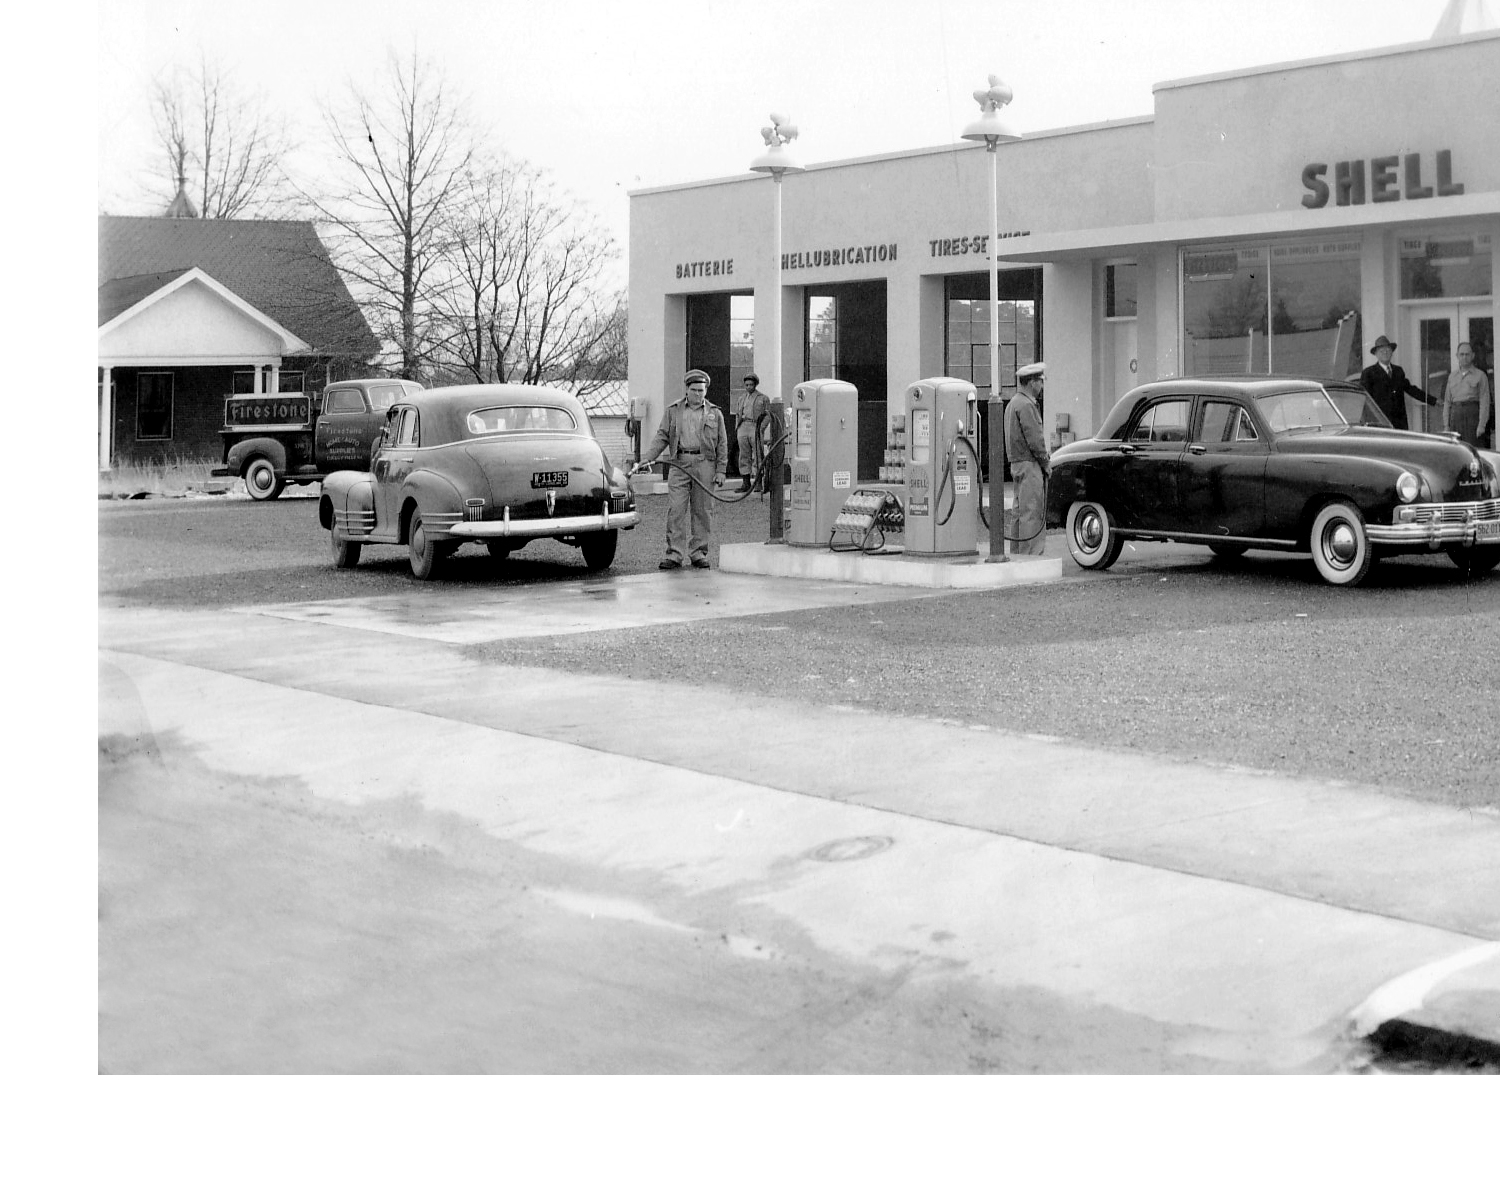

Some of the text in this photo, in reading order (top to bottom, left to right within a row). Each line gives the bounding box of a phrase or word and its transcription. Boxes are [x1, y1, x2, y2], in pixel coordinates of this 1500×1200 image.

[1301, 150, 1464, 209] SHELL
[772, 244, 898, 270] HELLUBRICATION
[675, 258, 733, 279] BATTERIE
[229, 402, 307, 420] Firestone
[794, 474, 810, 483] SHELL
[910, 479, 927, 488] SHELL
